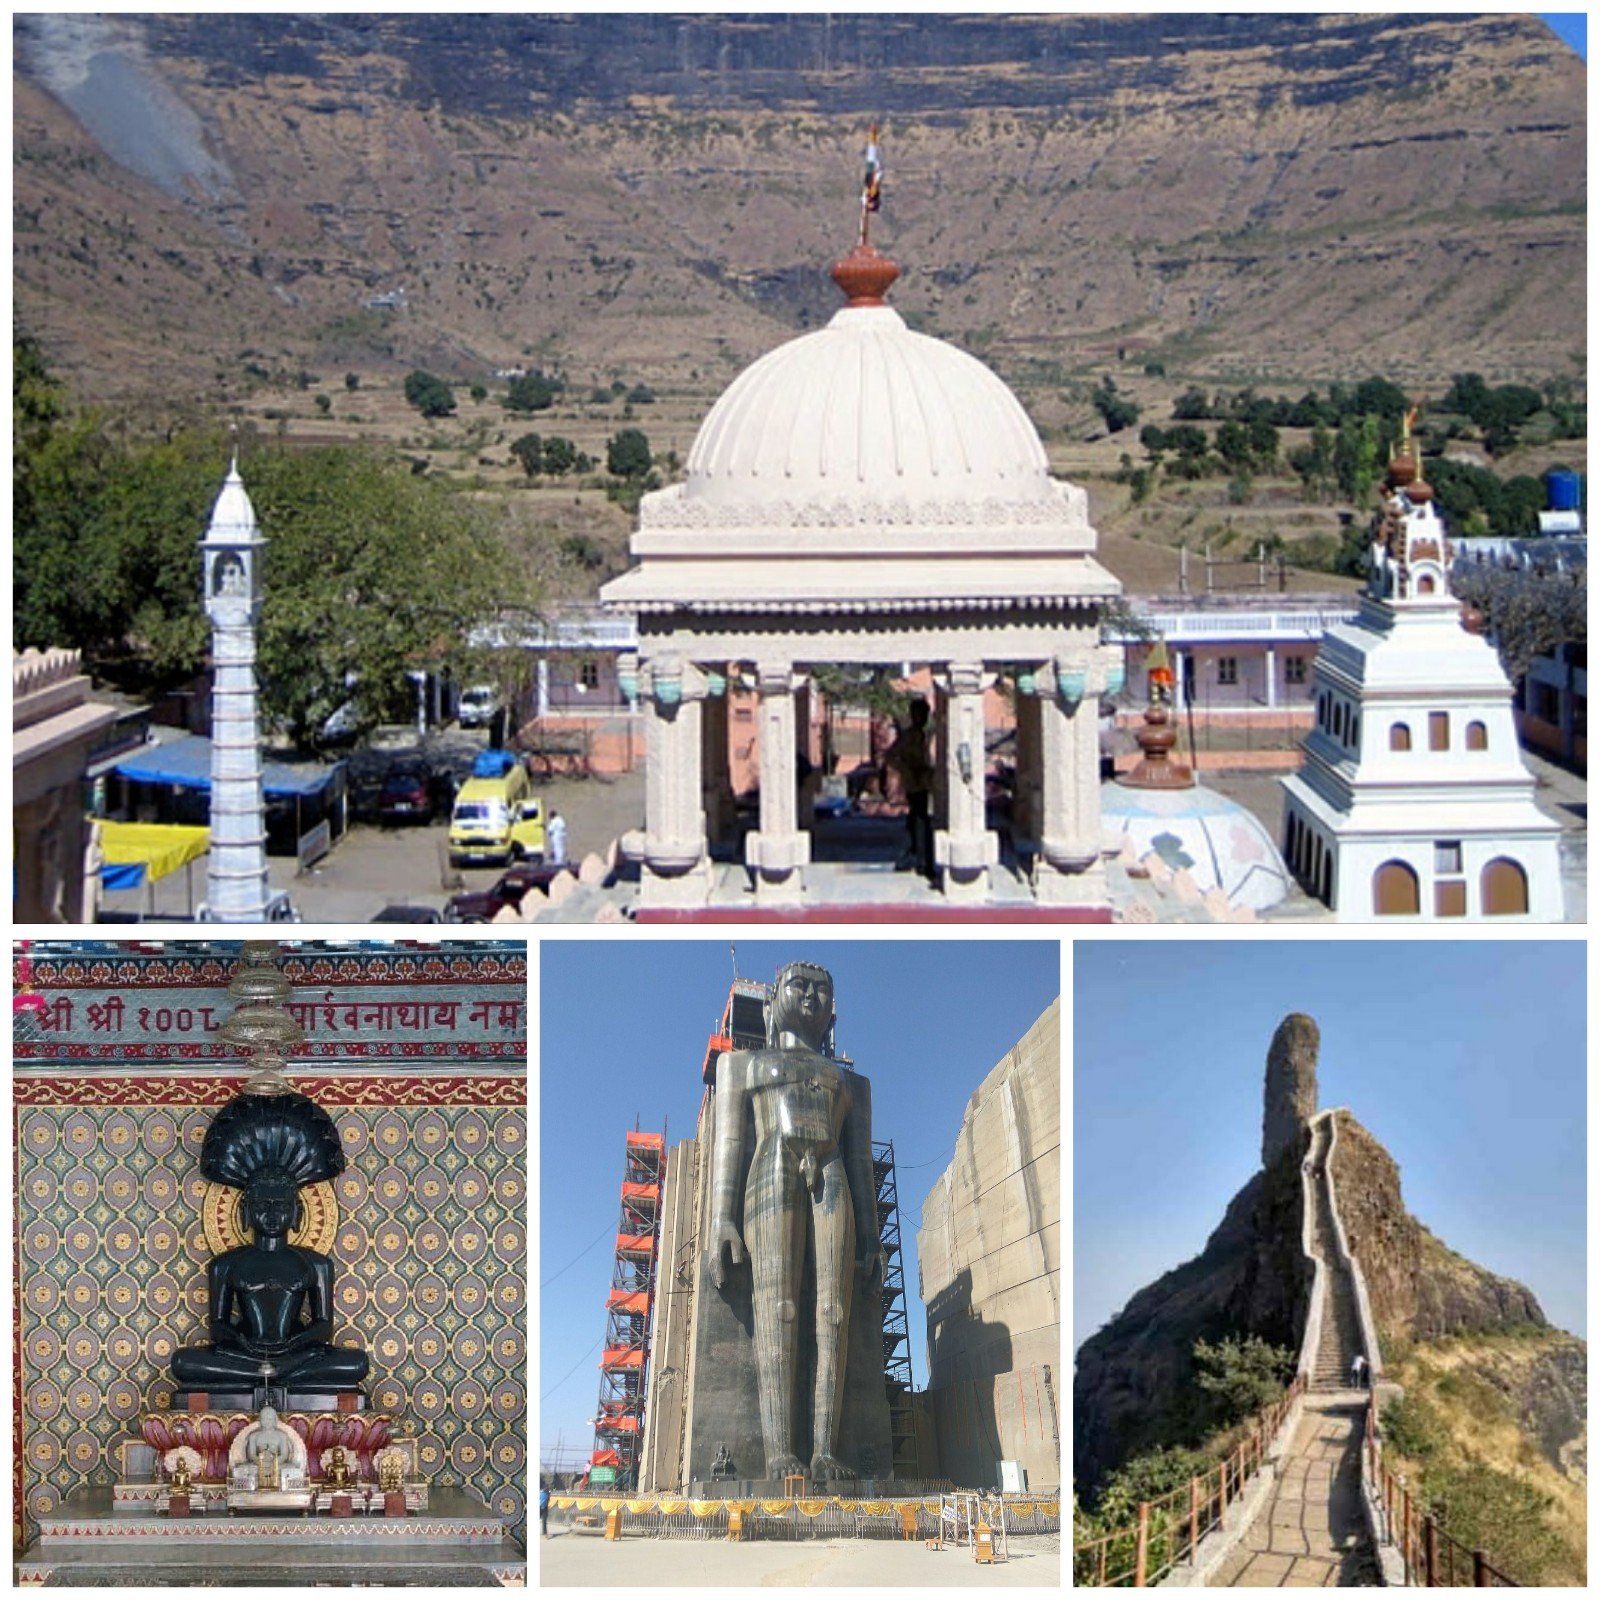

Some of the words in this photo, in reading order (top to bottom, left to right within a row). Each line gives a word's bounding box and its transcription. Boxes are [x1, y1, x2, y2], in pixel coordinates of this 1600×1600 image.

[36, 996, 74, 1032] श्री
[86, 995, 125, 1032] श्री
[138, 1007, 220, 1032] १००८
